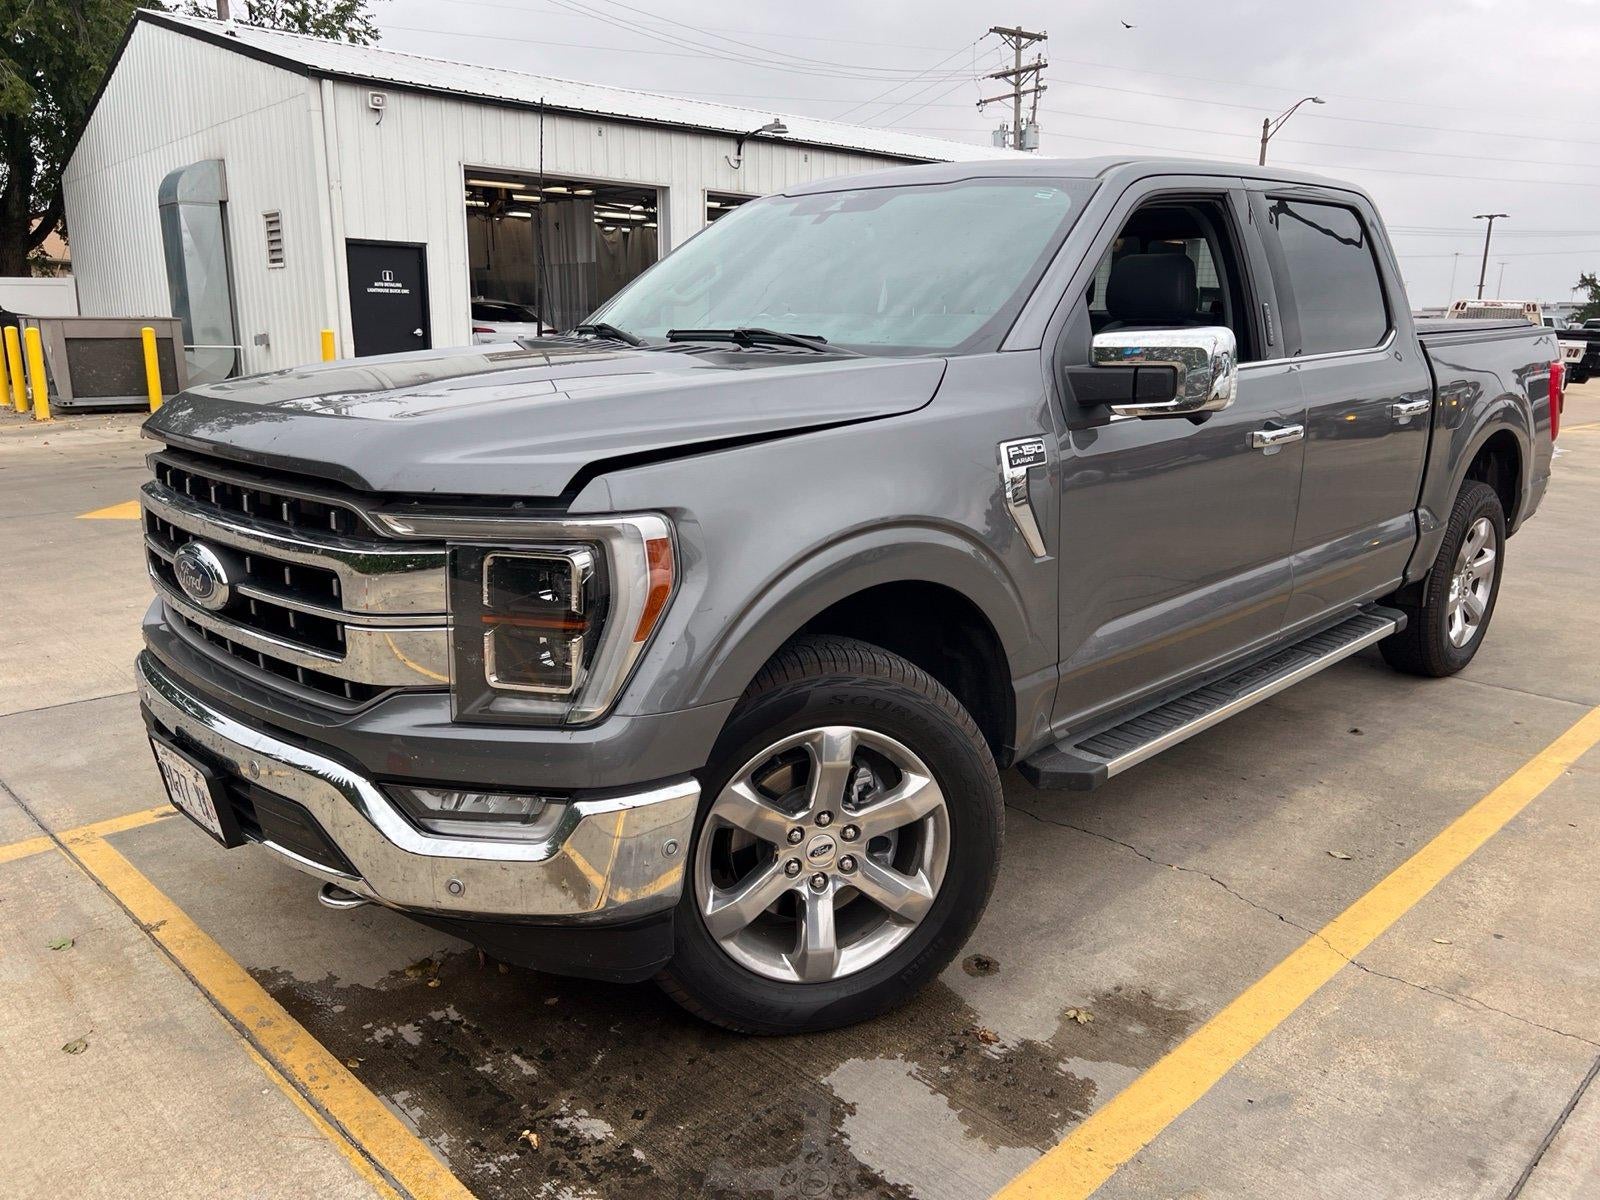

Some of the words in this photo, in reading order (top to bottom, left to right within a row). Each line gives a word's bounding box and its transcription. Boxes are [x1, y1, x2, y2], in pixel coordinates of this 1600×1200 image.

[1009, 444, 1044, 458] F-150
[1012, 456, 1034, 465] LARIAT
[180, 560, 204, 592] Ford
